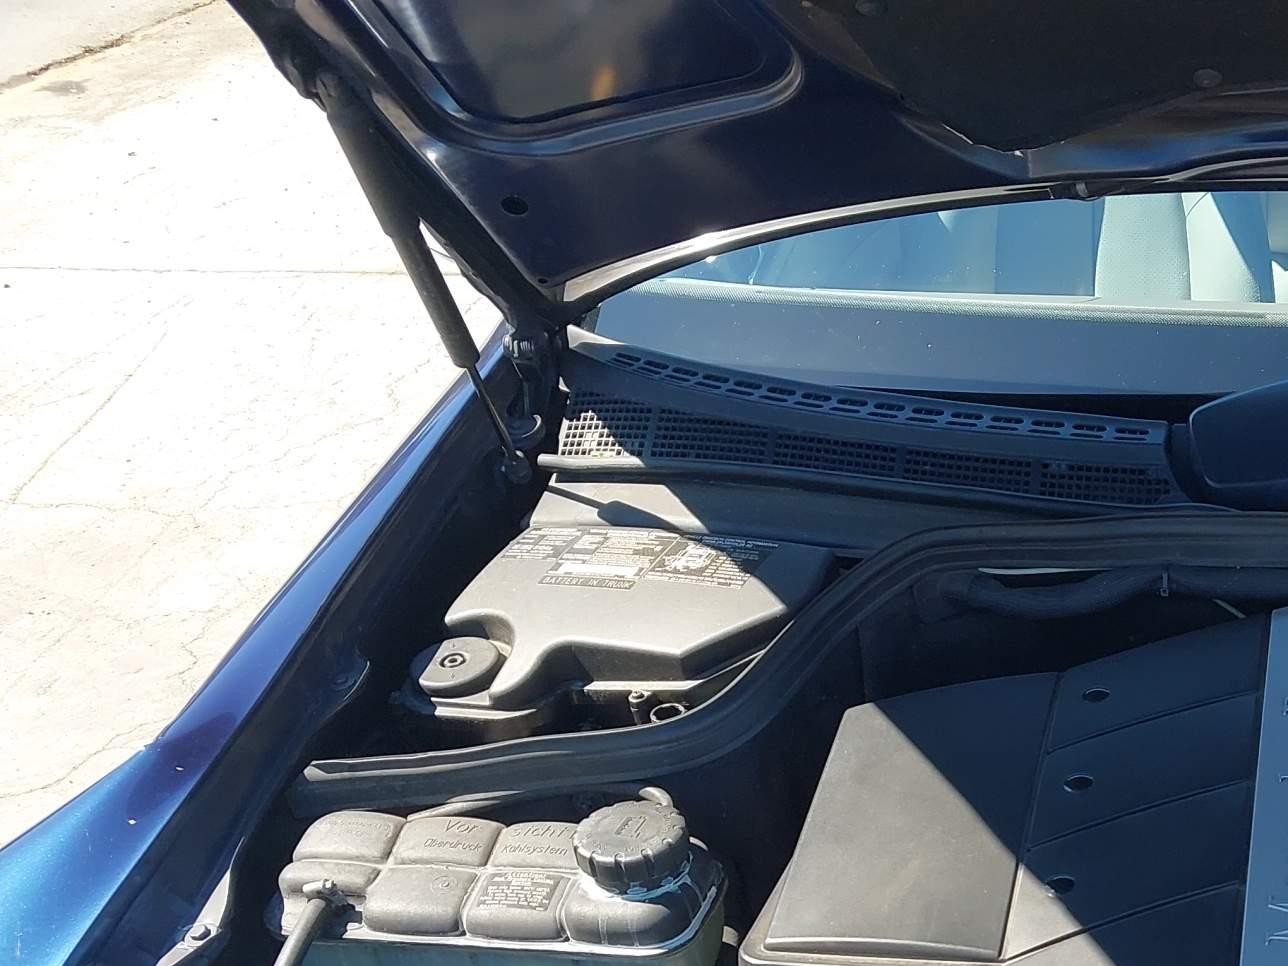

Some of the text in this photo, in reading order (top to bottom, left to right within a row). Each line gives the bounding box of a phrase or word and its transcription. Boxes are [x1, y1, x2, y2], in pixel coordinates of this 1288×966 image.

[542, 576, 634, 589] BATTERY IN TRUNK
